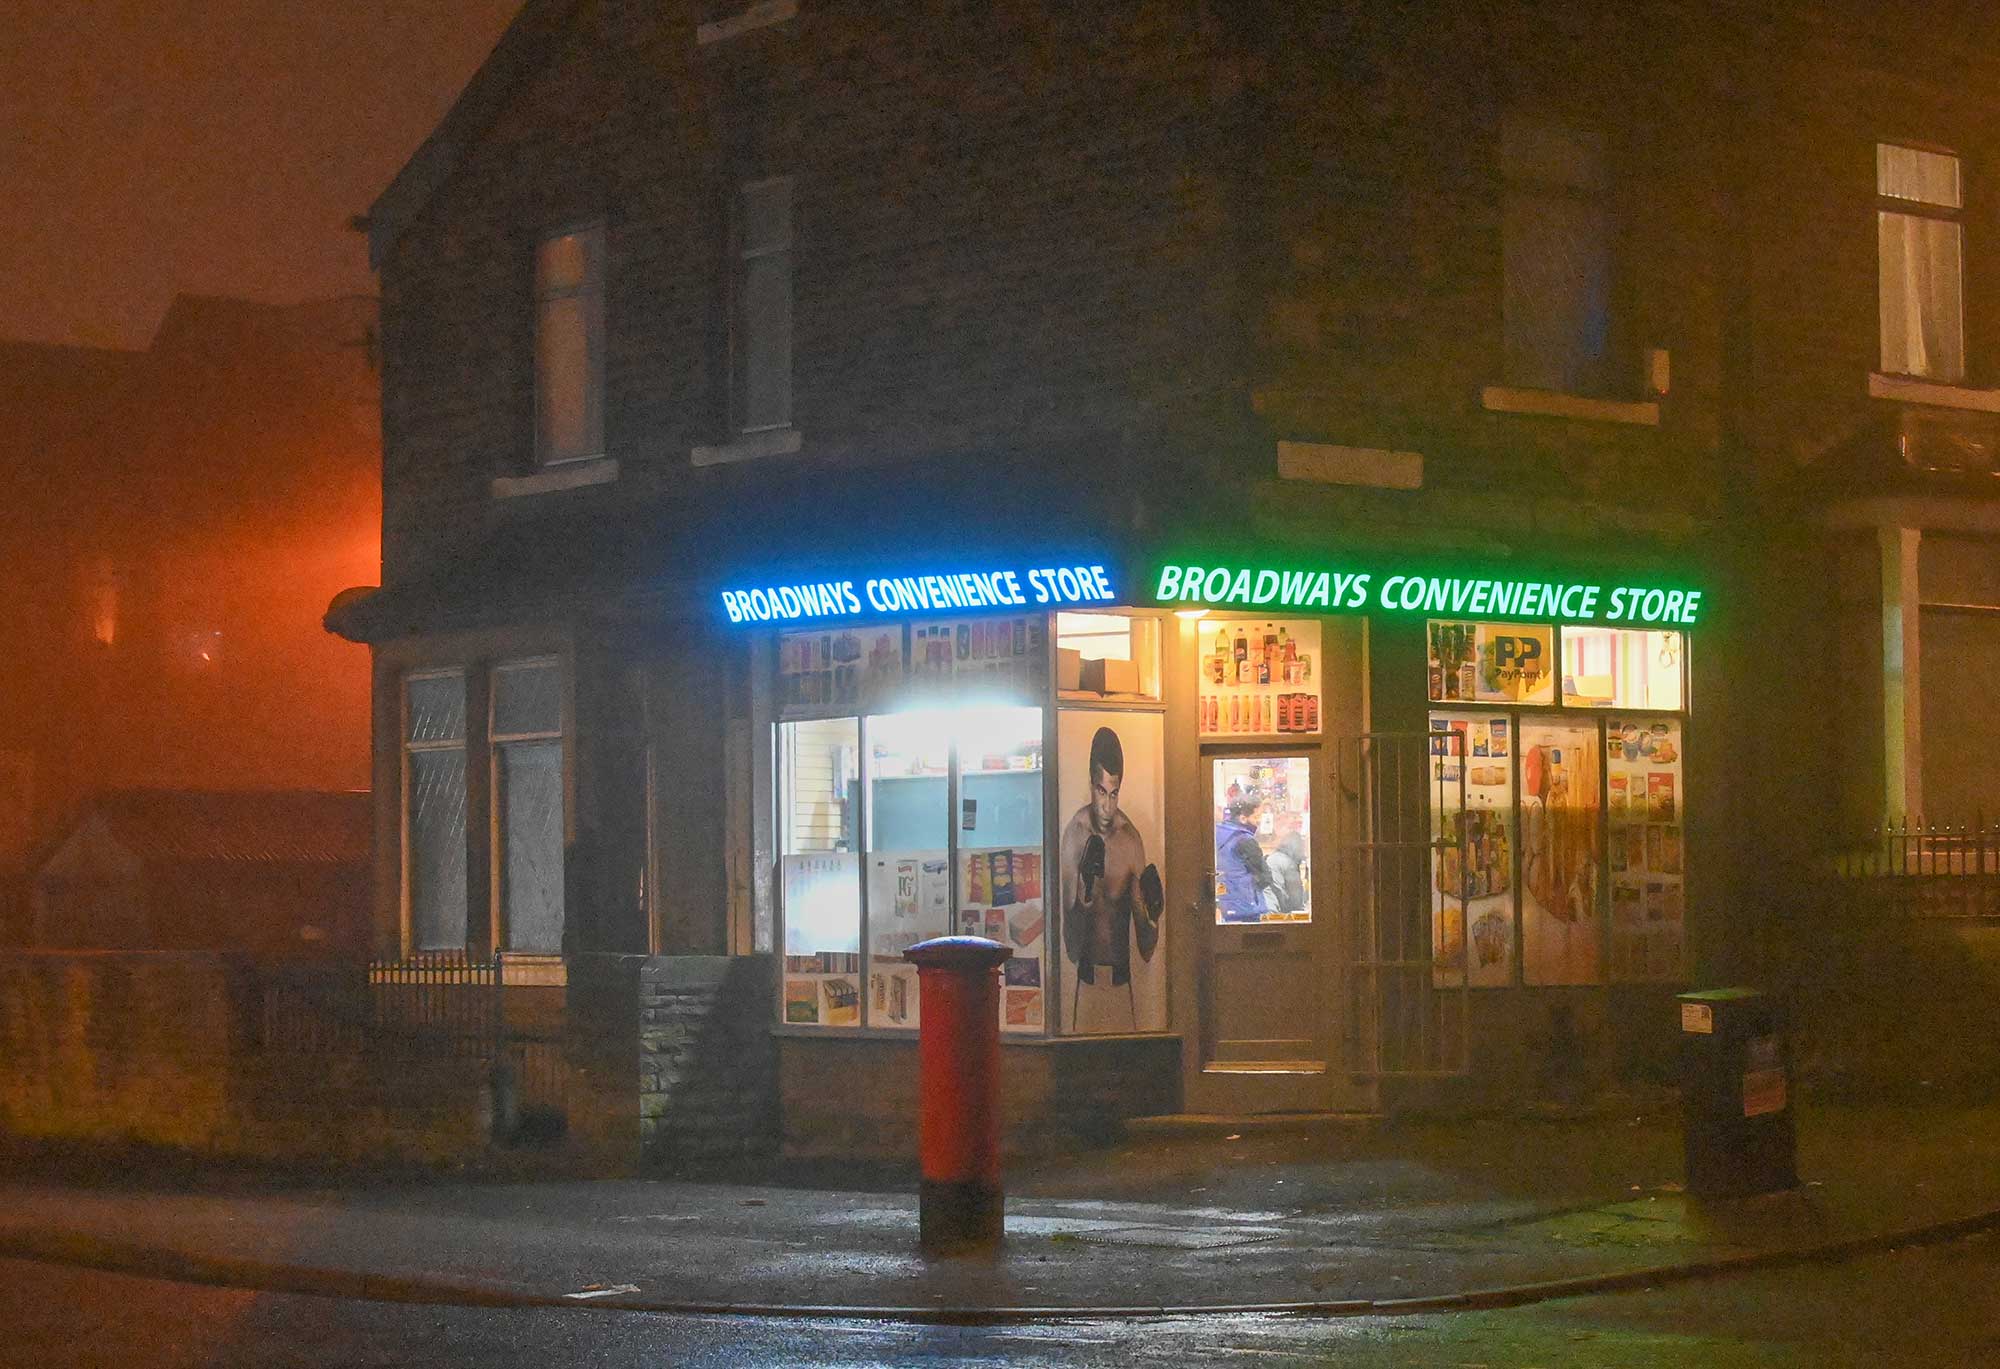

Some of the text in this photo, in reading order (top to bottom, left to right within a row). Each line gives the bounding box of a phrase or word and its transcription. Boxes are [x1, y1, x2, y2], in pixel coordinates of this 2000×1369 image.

[722, 566, 1115, 622] BROADWAYS CONVENIENCE STORE
[1156, 565, 1701, 623] BROADWAYS CONVENIENCE STORE
[1495, 667, 1542, 681] PayPoint
